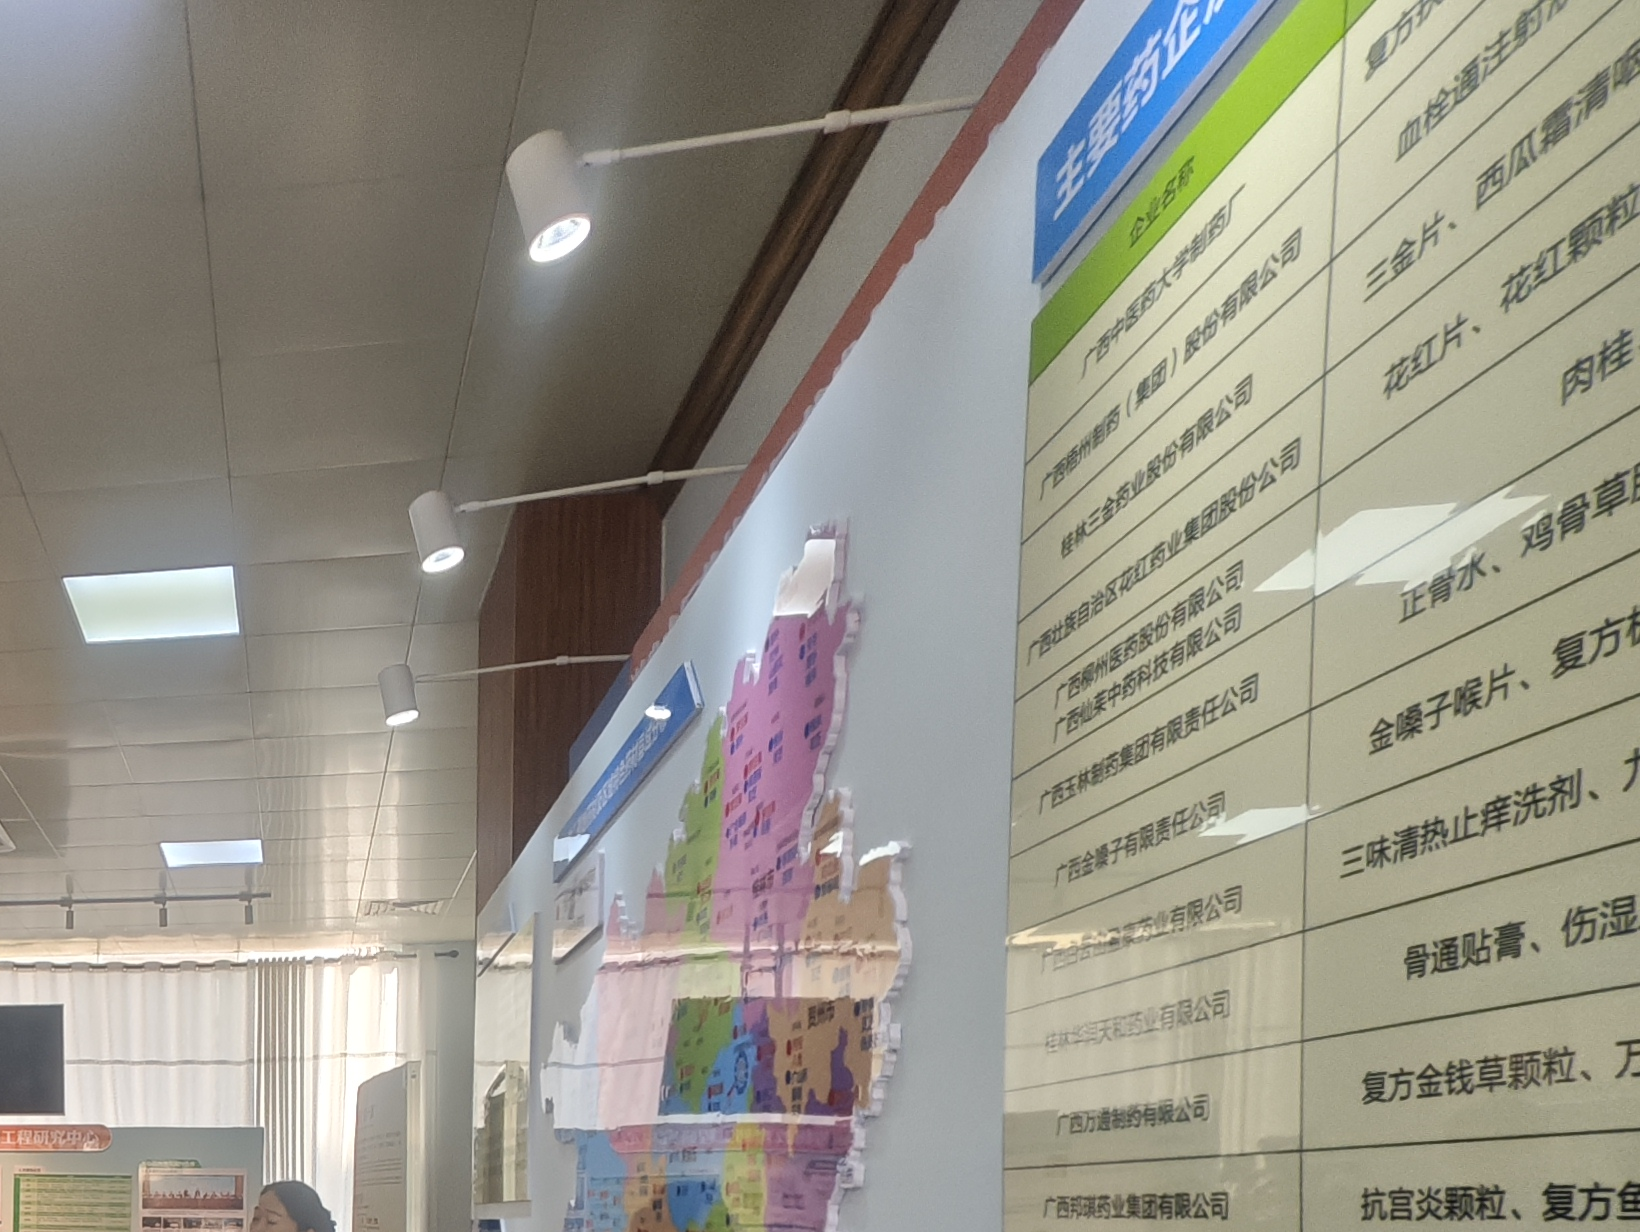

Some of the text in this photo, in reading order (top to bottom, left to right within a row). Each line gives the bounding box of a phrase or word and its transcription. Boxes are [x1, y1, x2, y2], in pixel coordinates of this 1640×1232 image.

[1053, 0, 1234, 221] 主要药企
[1129, 155, 1196, 248] 企业名称
[1078, 183, 1246, 383] 广西中医药大学制药厂
[1561, 328, 1640, 406] 肉桂
[1060, 373, 1254, 559] 桂林三金药业股份有限公司
[1026, 436, 1301, 667] 广西壮族自治区花红药业集团股份公司
[1054, 559, 1244, 710] 广西柳州医药股份有限公司
[1038, 672, 1260, 815] 广西玉林制药集团有限责任公司
[1054, 791, 1226, 887] 广西金嗓子有限责任公司
[1403, 894, 1640, 981] 骨通贴膏、伤湿
[1043, 1191, 1229, 1221] 广西邦琪药业集团有限公司
